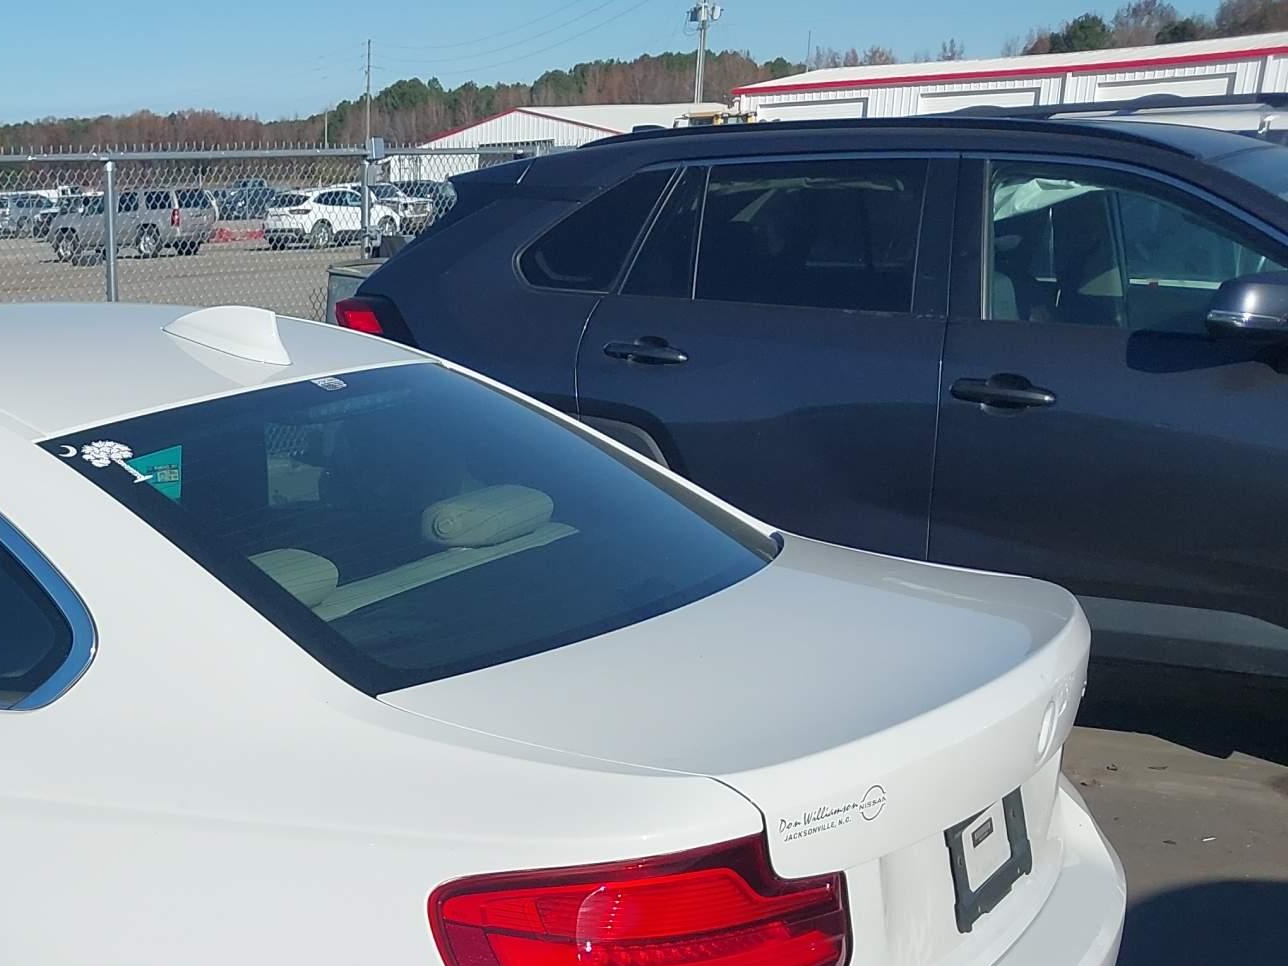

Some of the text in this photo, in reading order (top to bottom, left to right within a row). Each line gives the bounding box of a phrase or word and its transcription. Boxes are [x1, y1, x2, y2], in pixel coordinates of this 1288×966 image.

[859, 796, 886, 810] NISSAN
[779, 802, 858, 833] Don Williamson
